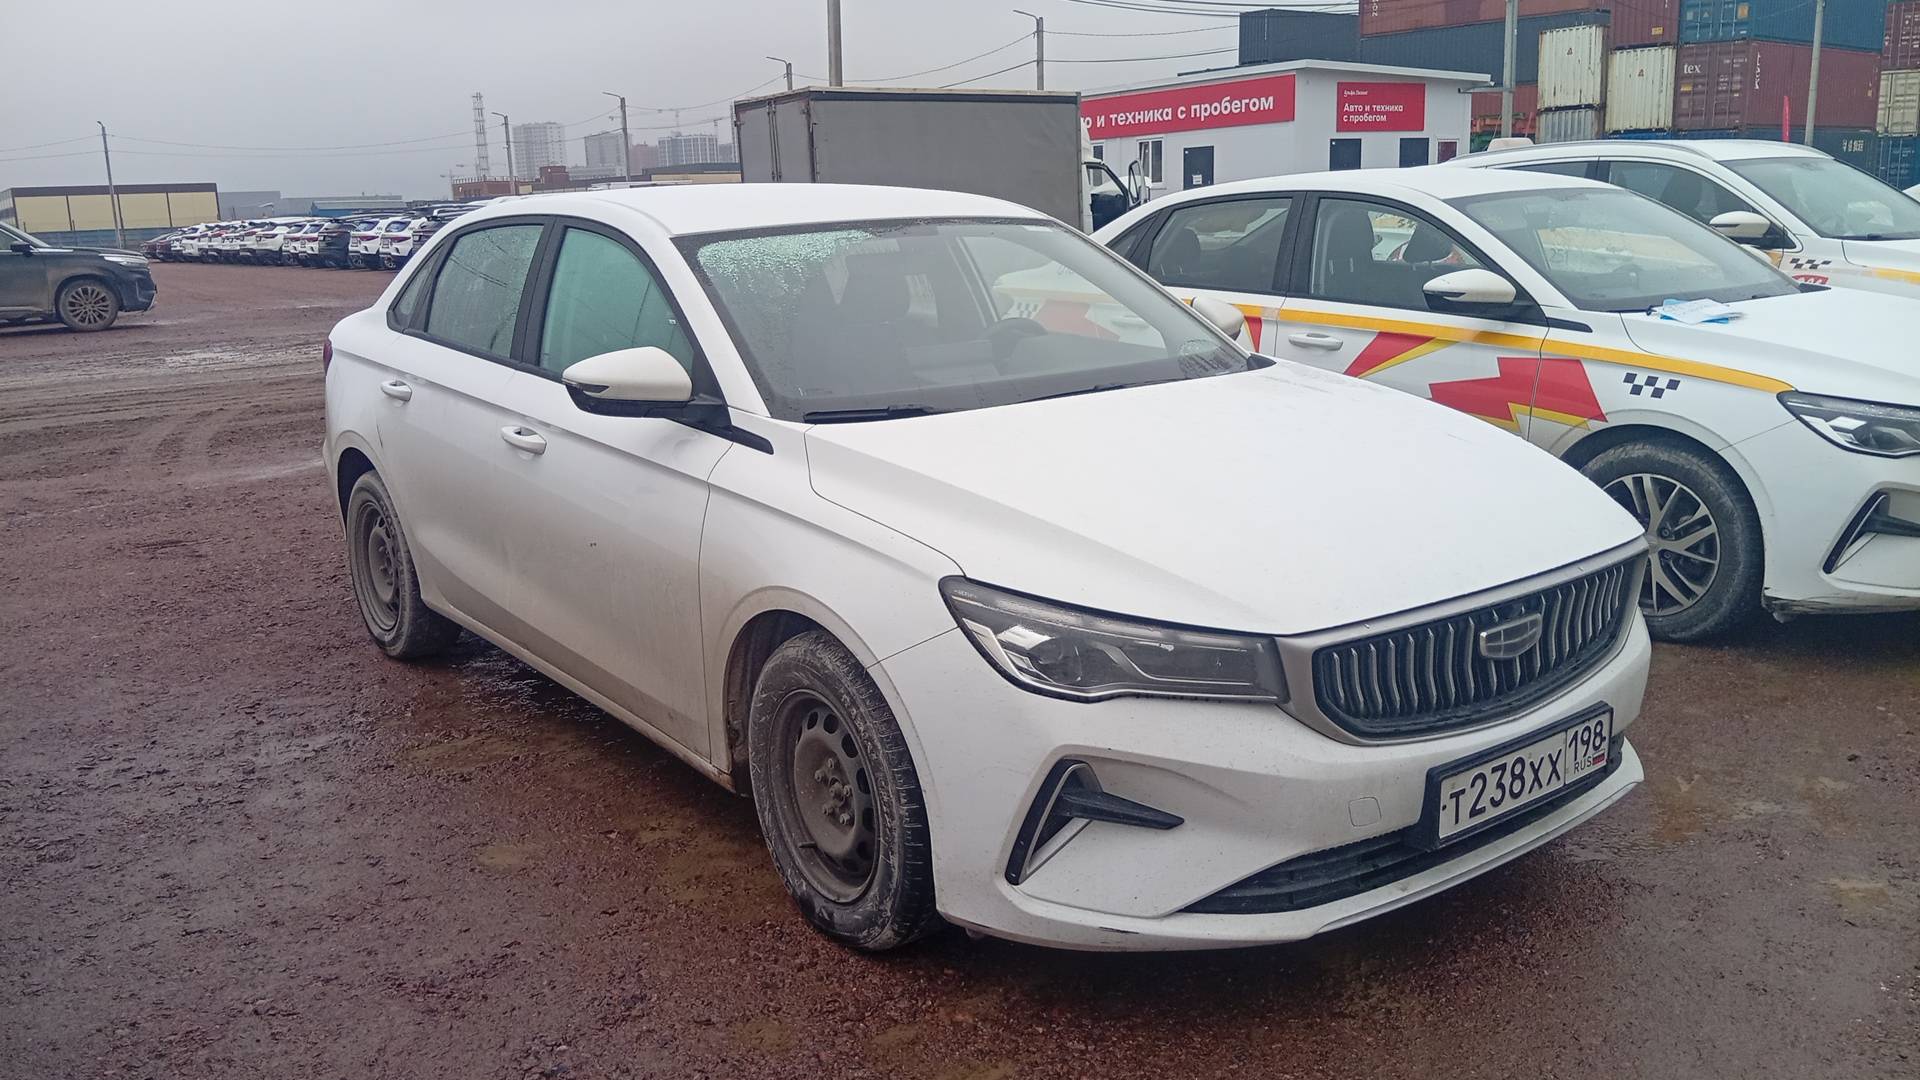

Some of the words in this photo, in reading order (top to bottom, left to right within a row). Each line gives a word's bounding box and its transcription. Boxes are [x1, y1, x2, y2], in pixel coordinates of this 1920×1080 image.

[1683, 63, 1701, 74] tex
[1096, 114, 1105, 128] и
[1109, 107, 1172, 126] техника
[1177, 105, 1186, 119] с
[1190, 96, 1274, 121] пробегом
[1343, 103, 1363, 112] Авто
[1372, 104, 1403, 112] техника
[1343, 114, 1348, 122] с
[1349, 112, 1387, 124] пробегом
[1574, 755, 1592, 774] RUS
[1449, 748, 1563, 825] Т238ХХ
[1568, 720, 1605, 761] 198
